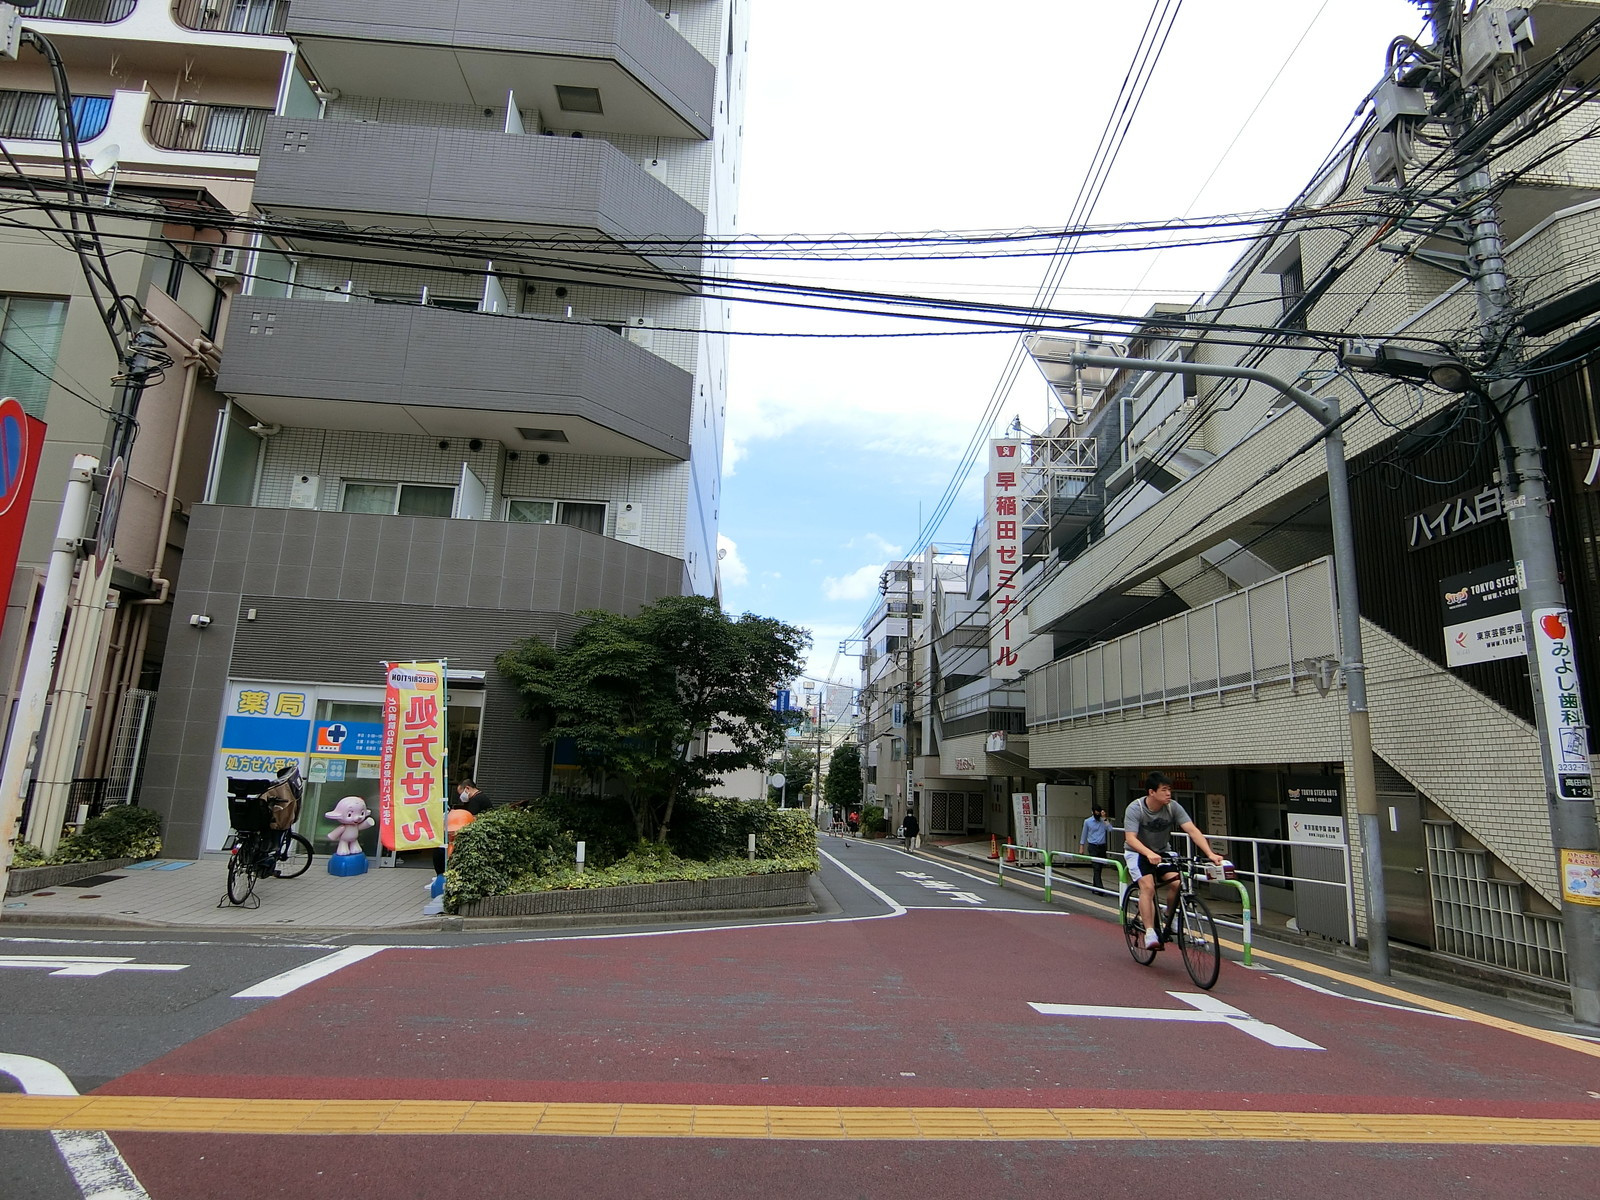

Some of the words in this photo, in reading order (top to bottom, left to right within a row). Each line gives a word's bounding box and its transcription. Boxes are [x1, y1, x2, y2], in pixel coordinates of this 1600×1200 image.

[996, 472, 1018, 667] 早稲田ゼミナール
[1470, 580, 1494, 595] TOKYO
[1551, 640, 1581, 726] みよし歯科
[237, 690, 306, 717] 薬局
[225, 754, 299, 774] 処方せん受付
